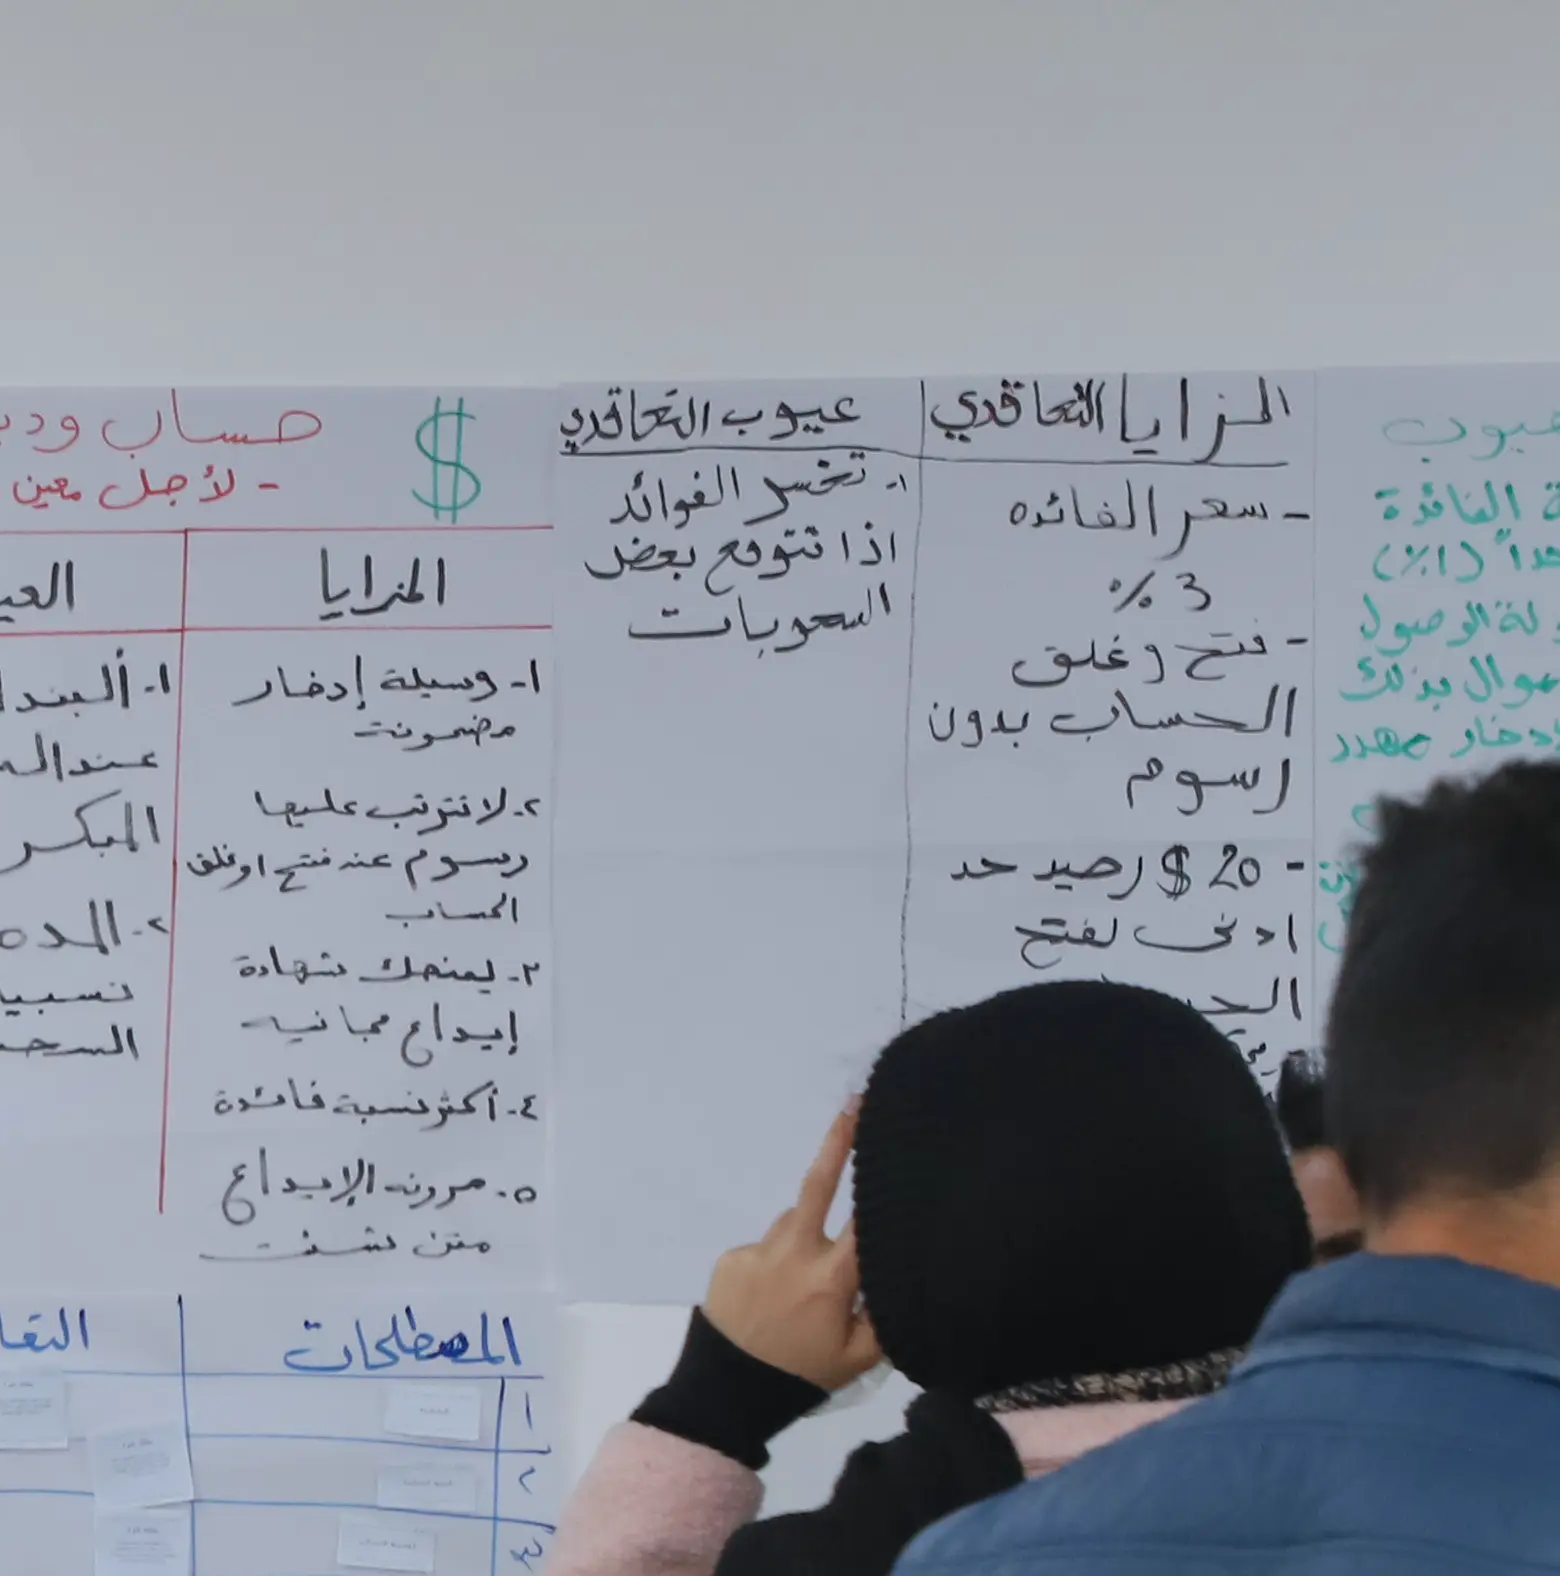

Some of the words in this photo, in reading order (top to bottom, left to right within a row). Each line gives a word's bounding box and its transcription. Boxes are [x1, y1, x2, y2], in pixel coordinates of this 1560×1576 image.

[103, 389, 321, 459] حساب
[721, 397, 862, 440] عيوب
[13, 476, 81, 508] معين
[100, 465, 233, 509] لأجل
[609, 464, 740, 529] الفوائد
[743, 451, 866, 527] تخسر
[843, 522, 897, 565] اذا
[1155, 498, 1268, 561] سعر
[584, 537, 696, 581] بعض
[705, 525, 824, 597] تتوقع
[320, 548, 445, 622] المزايا
[1174, 617, 1268, 681] فتح
[231, 654, 366, 710] إدخار
[380, 668, 498, 702] وسيلة
[928, 701, 1029, 749] بدون
[1050, 683, 1298, 743] الحساب
[69, 751, 158, 776] عند
[1126, 756, 1290, 816] رسوم
[255, 788, 358, 828] عليها
[405, 849, 528, 890] رسوم
[950, 856, 1018, 880] حد
[1033, 855, 1143, 900] رصيد
[1209, 843, 1261, 891] 20
[234, 946, 347, 984] شهادة
[1015, 917, 1118, 969] لفتح
[401, 1002, 518, 1068] إيداع
[214, 1077, 326, 1115] فائدة
[333, 1089, 430, 1125] نسبة
[283, 1306, 521, 1374] المصطلحات
